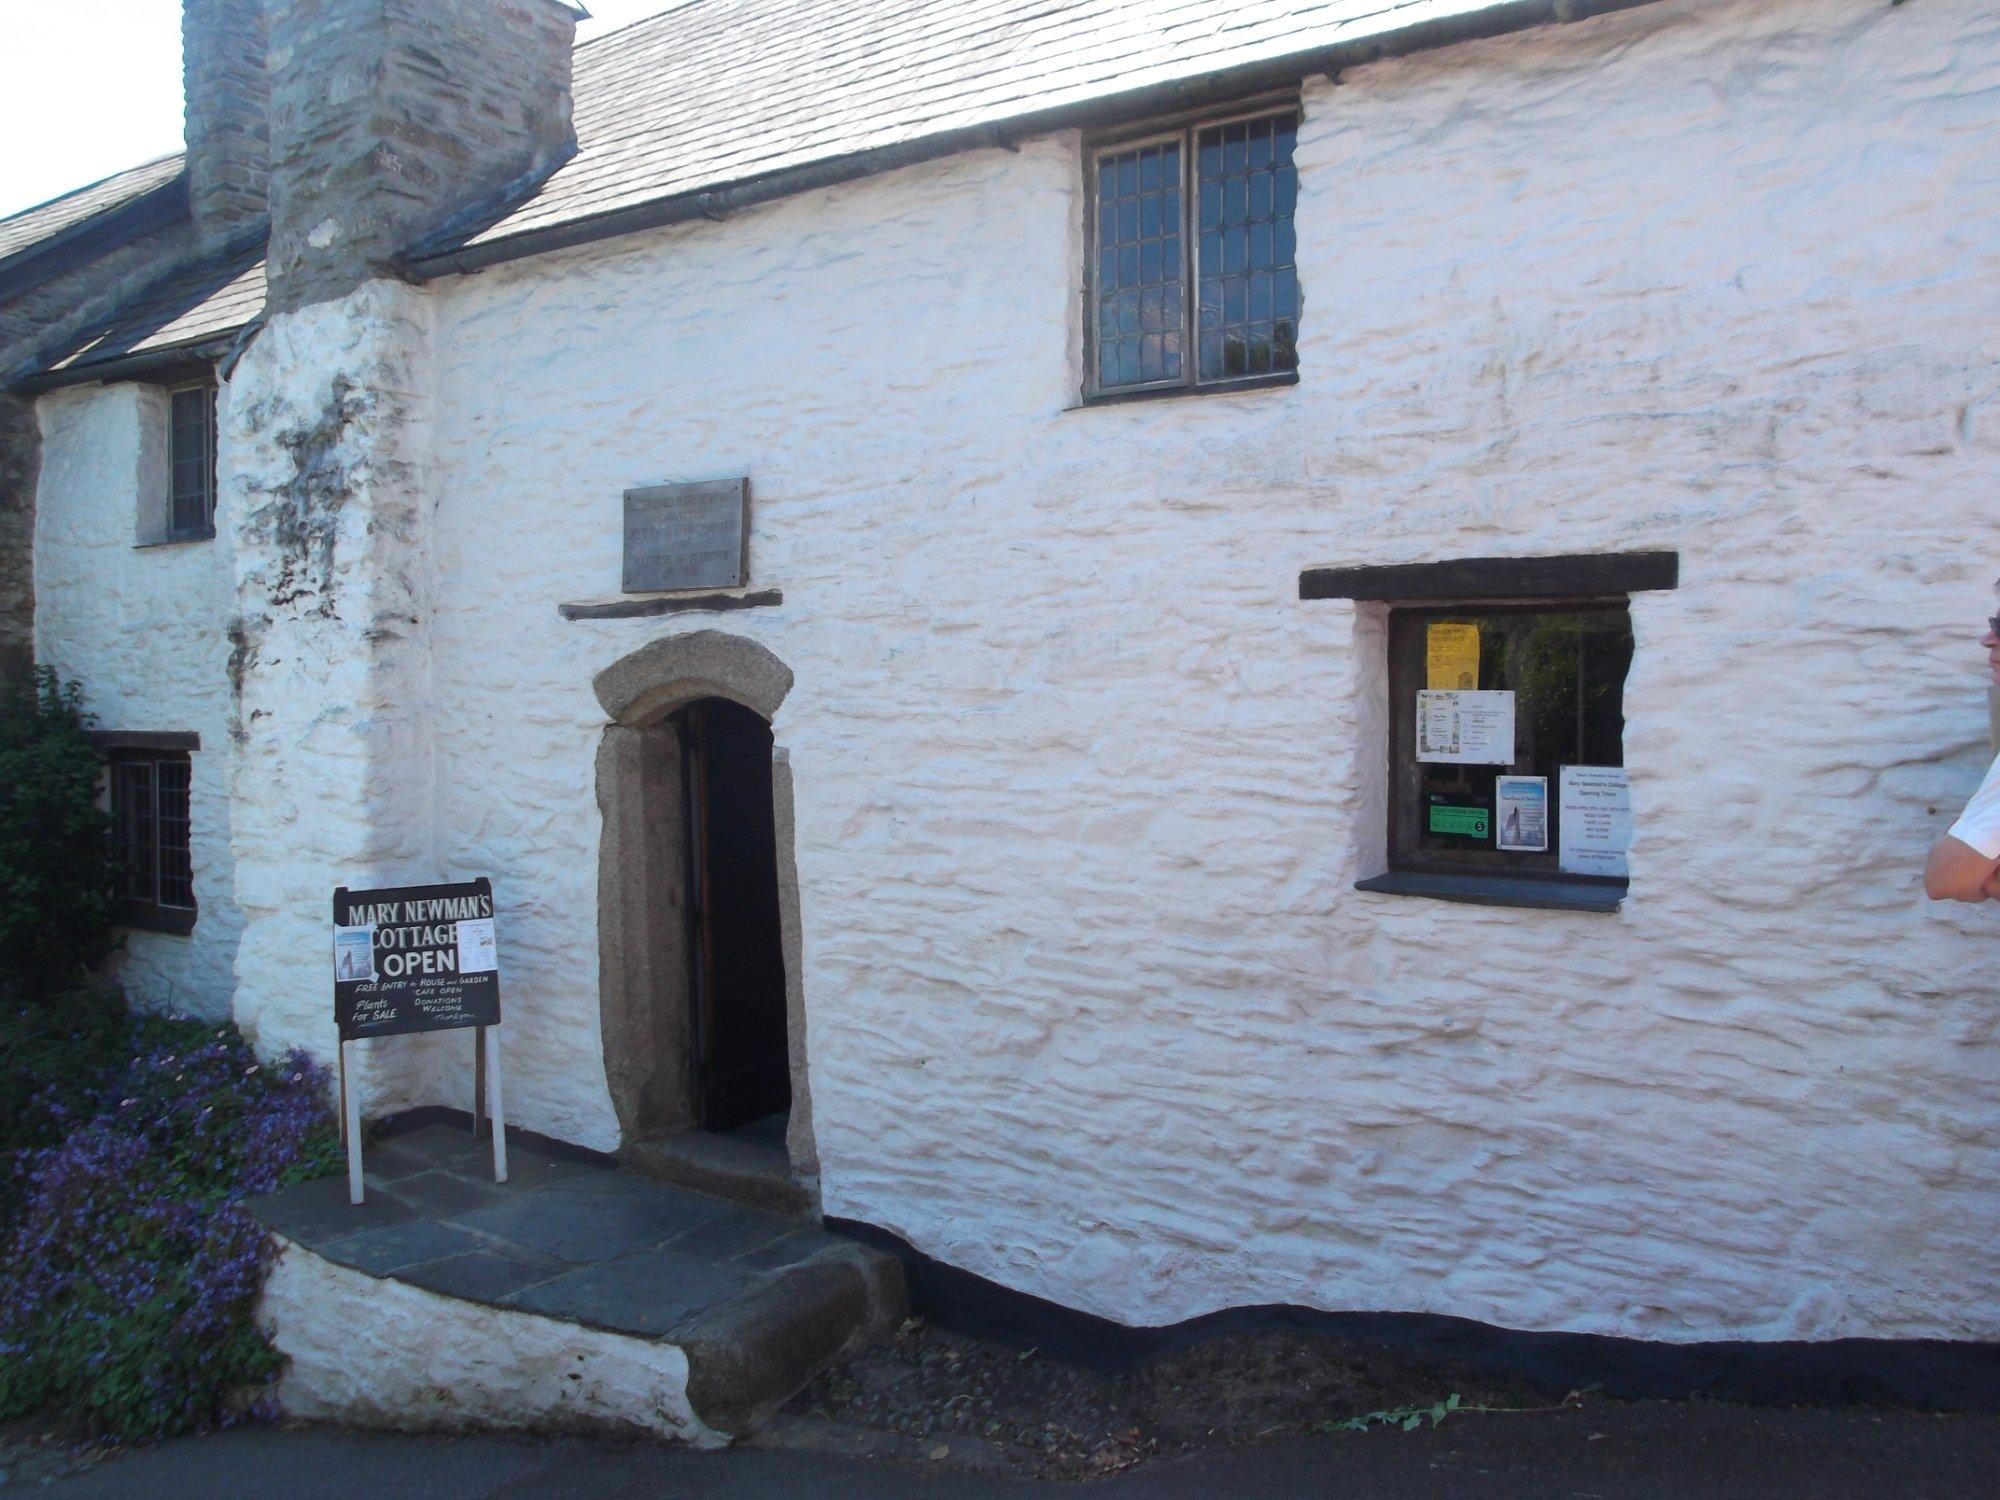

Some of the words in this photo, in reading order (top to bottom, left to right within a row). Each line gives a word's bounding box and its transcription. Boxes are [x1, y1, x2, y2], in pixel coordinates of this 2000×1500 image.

[1477, 822, 1483, 831] 5
[349, 903, 399, 926] MARY
[405, 894, 490, 923] NEWMAN'S
[383, 949, 455, 977] OPEN
[355, 983, 379, 993] FREE
[381, 980, 408, 991] ENTRY
[420, 978, 446, 987] HOUSE
[459, 976, 489, 984] GARDEN
[415, 988, 435, 996] CAFE
[356, 998, 388, 1010] Plants
[422, 1004, 463, 1013] WELCOME
[372, 1008, 398, 1020] SALE
